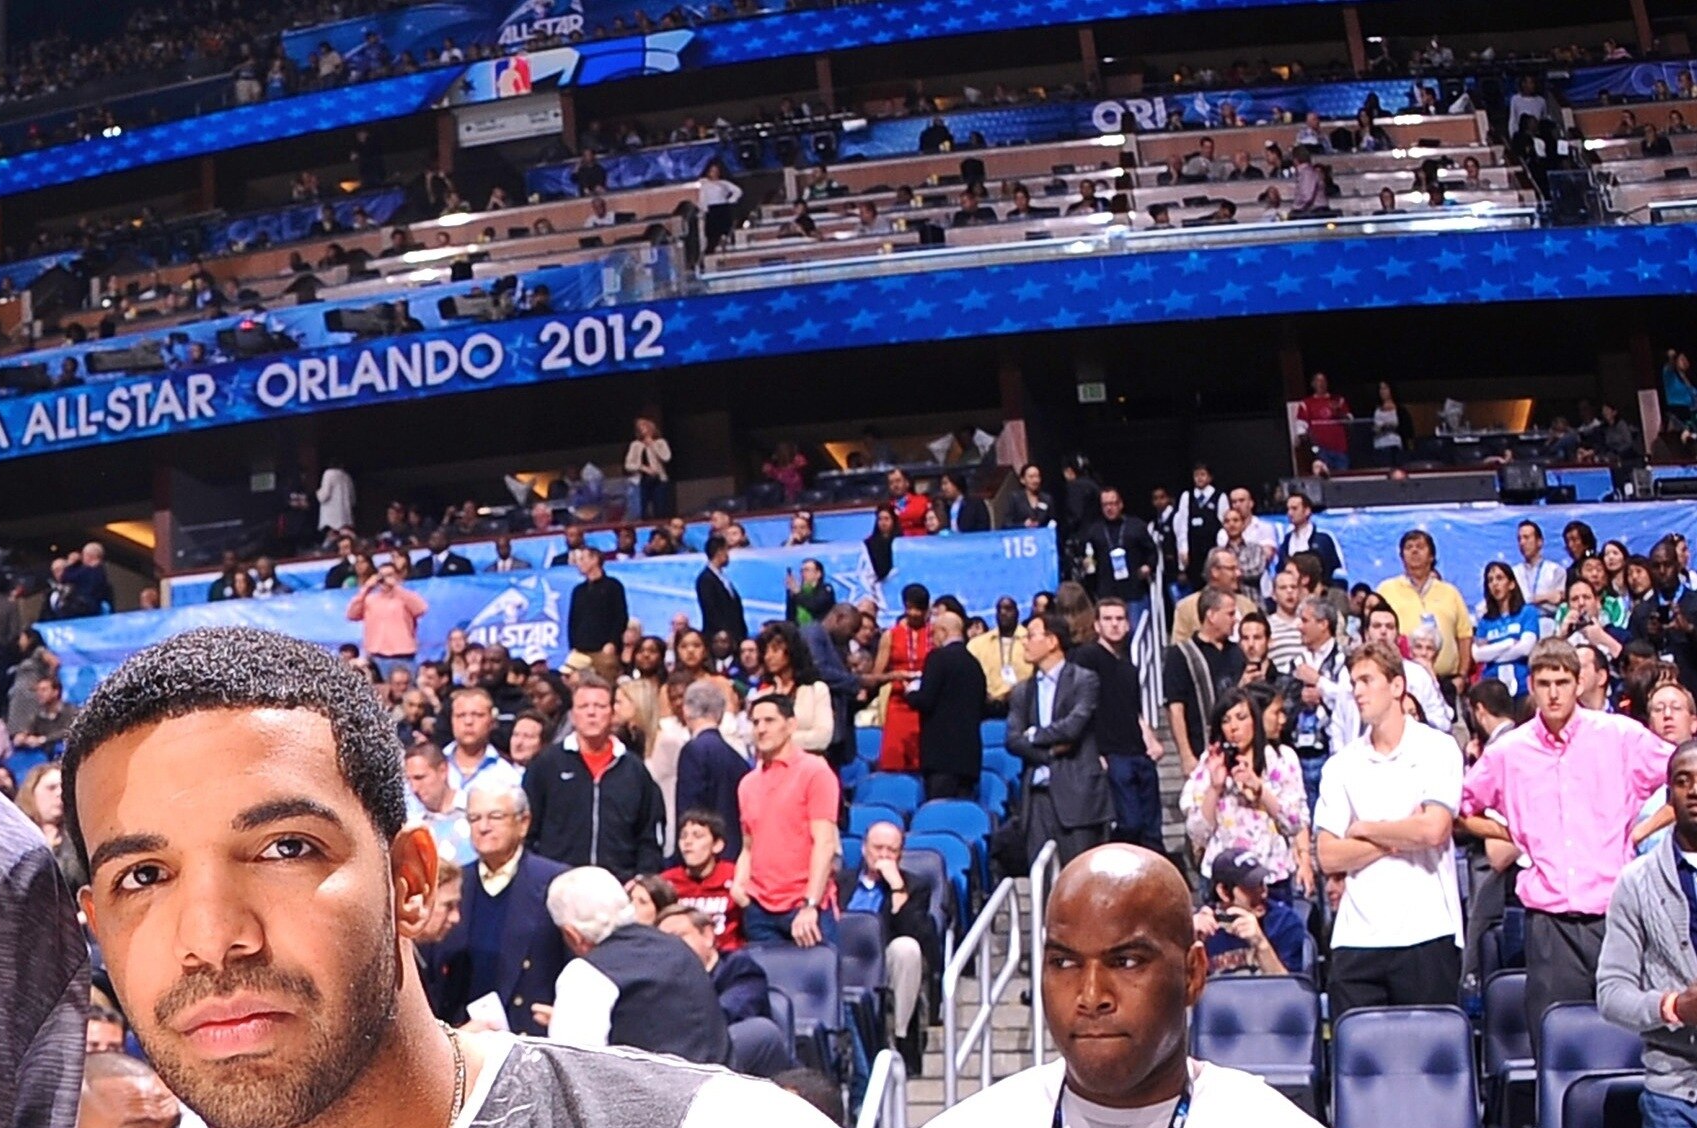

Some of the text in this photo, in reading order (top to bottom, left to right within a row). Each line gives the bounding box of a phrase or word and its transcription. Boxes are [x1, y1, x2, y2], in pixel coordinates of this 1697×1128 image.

[22, 373, 216, 446] ALL-STAR
[257, 333, 503, 407] ORLANDO
[539, 309, 664, 371] 2012
[1003, 536, 1038, 559] 115
